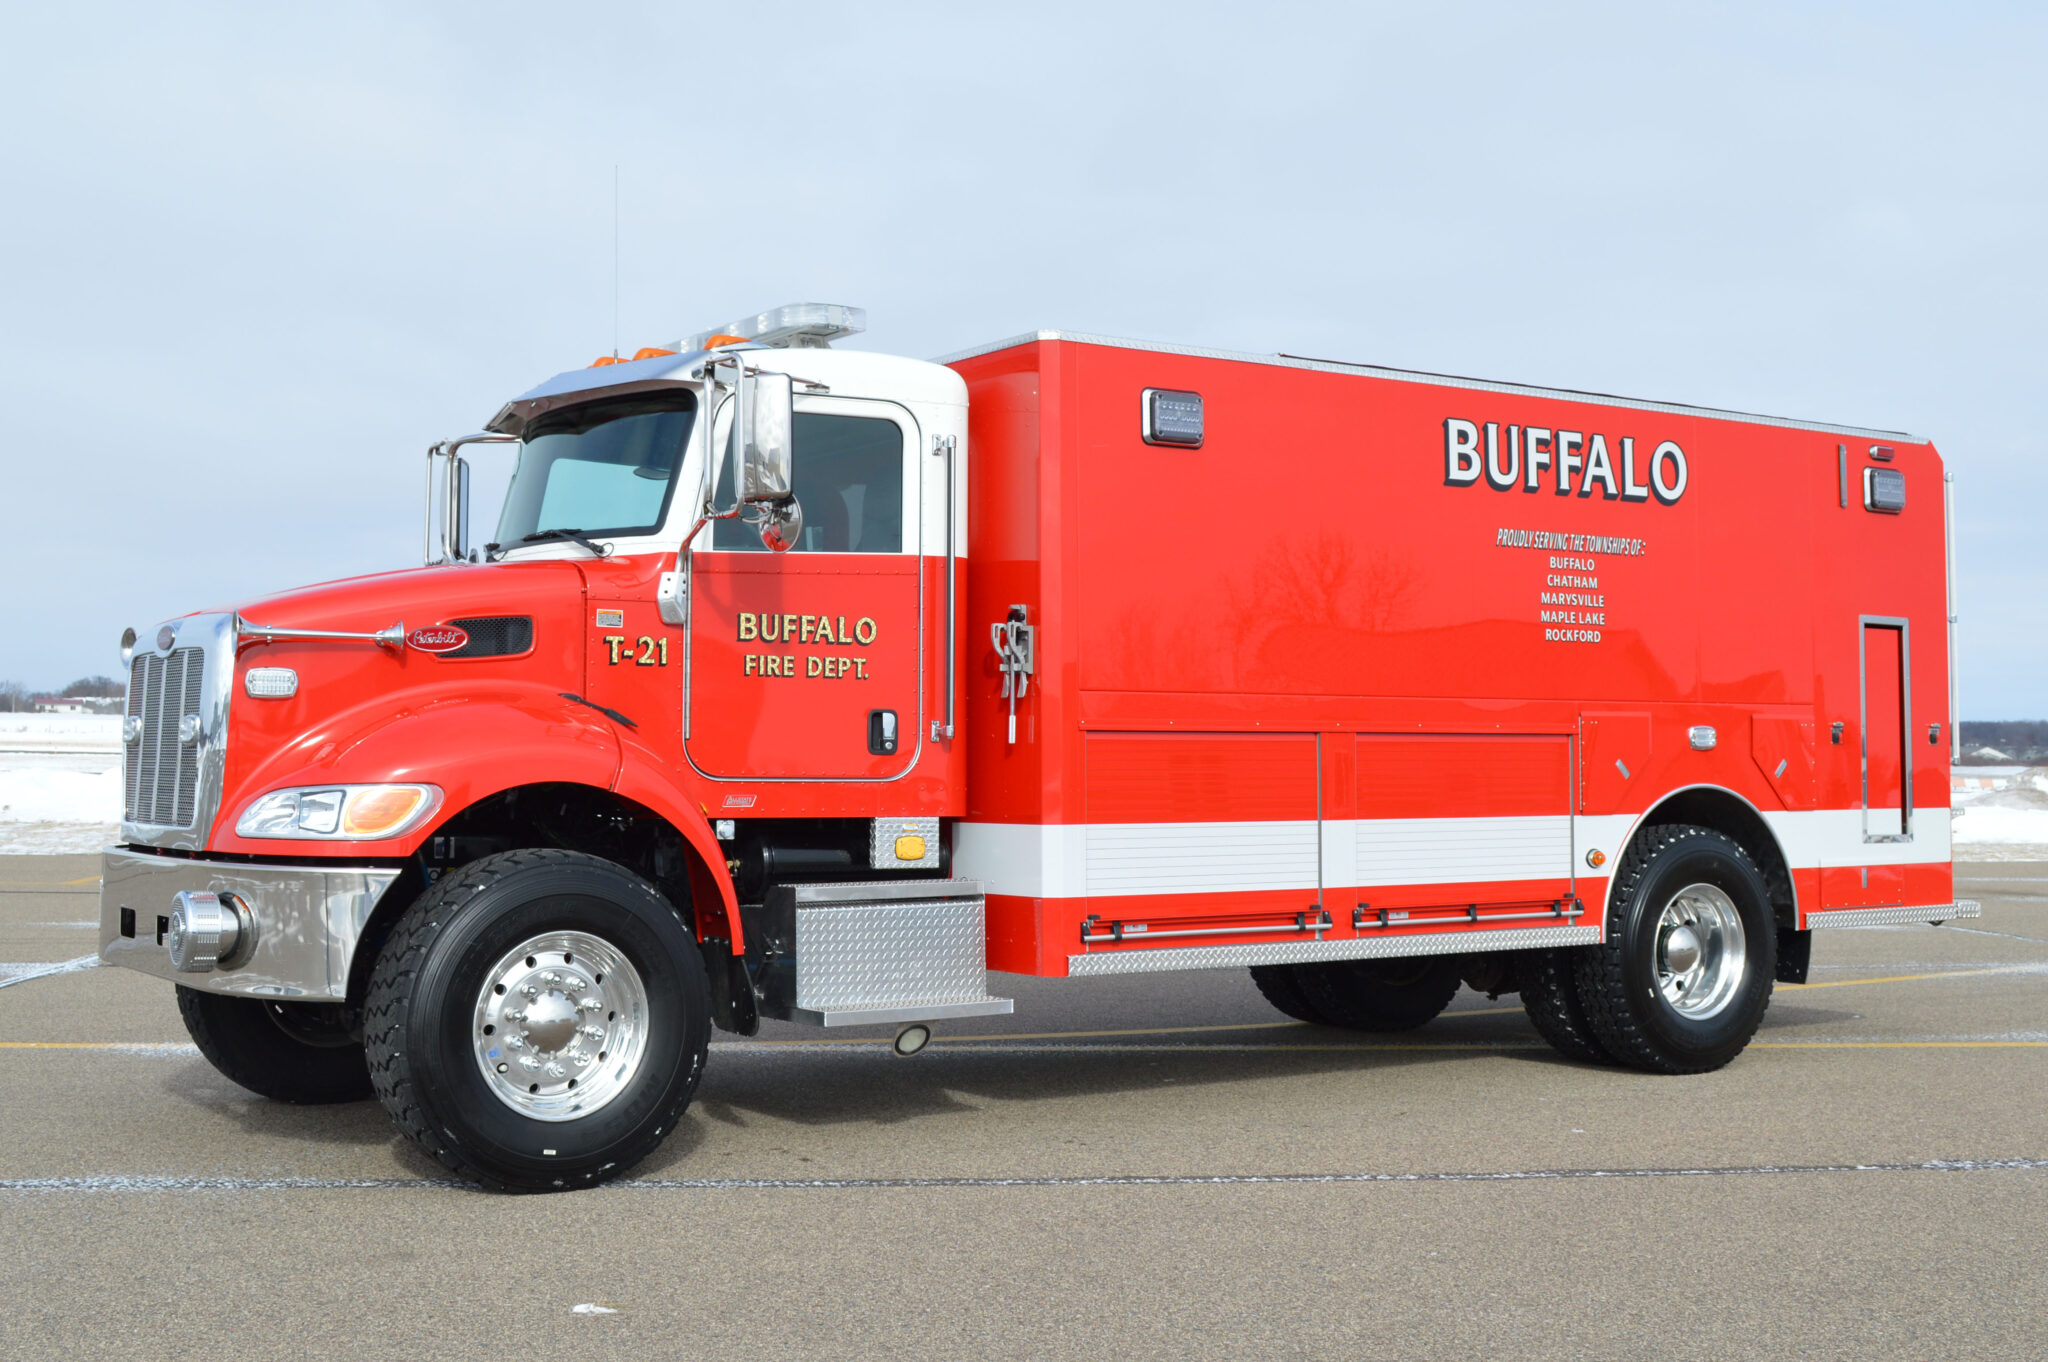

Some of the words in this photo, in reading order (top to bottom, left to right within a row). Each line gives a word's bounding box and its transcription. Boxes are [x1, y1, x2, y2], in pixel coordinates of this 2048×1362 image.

[1443, 417, 1688, 506] BUFFALO
[1496, 528, 1534, 548] PROUDLY
[1534, 531, 1568, 551] SERVING
[1569, 534, 1584, 552] THE
[1585, 535, 1630, 555] TOWNSHIPS
[1549, 556, 1595, 571] BUFFALO
[1547, 574, 1598, 588] CHATHAM
[1541, 592, 1605, 607] MARYSVILLE
[1541, 610, 1576, 624] MAPLE
[1578, 612, 1605, 625] LAKE
[737, 612, 877, 646] BUFFALO
[1545, 628, 1601, 643] ROCKFORD
[413, 630, 462, 645] Peterbilt
[603, 635, 667, 666] T-21
[744, 654, 795, 677] FIRE
[806, 656, 869, 680] DEPT.
